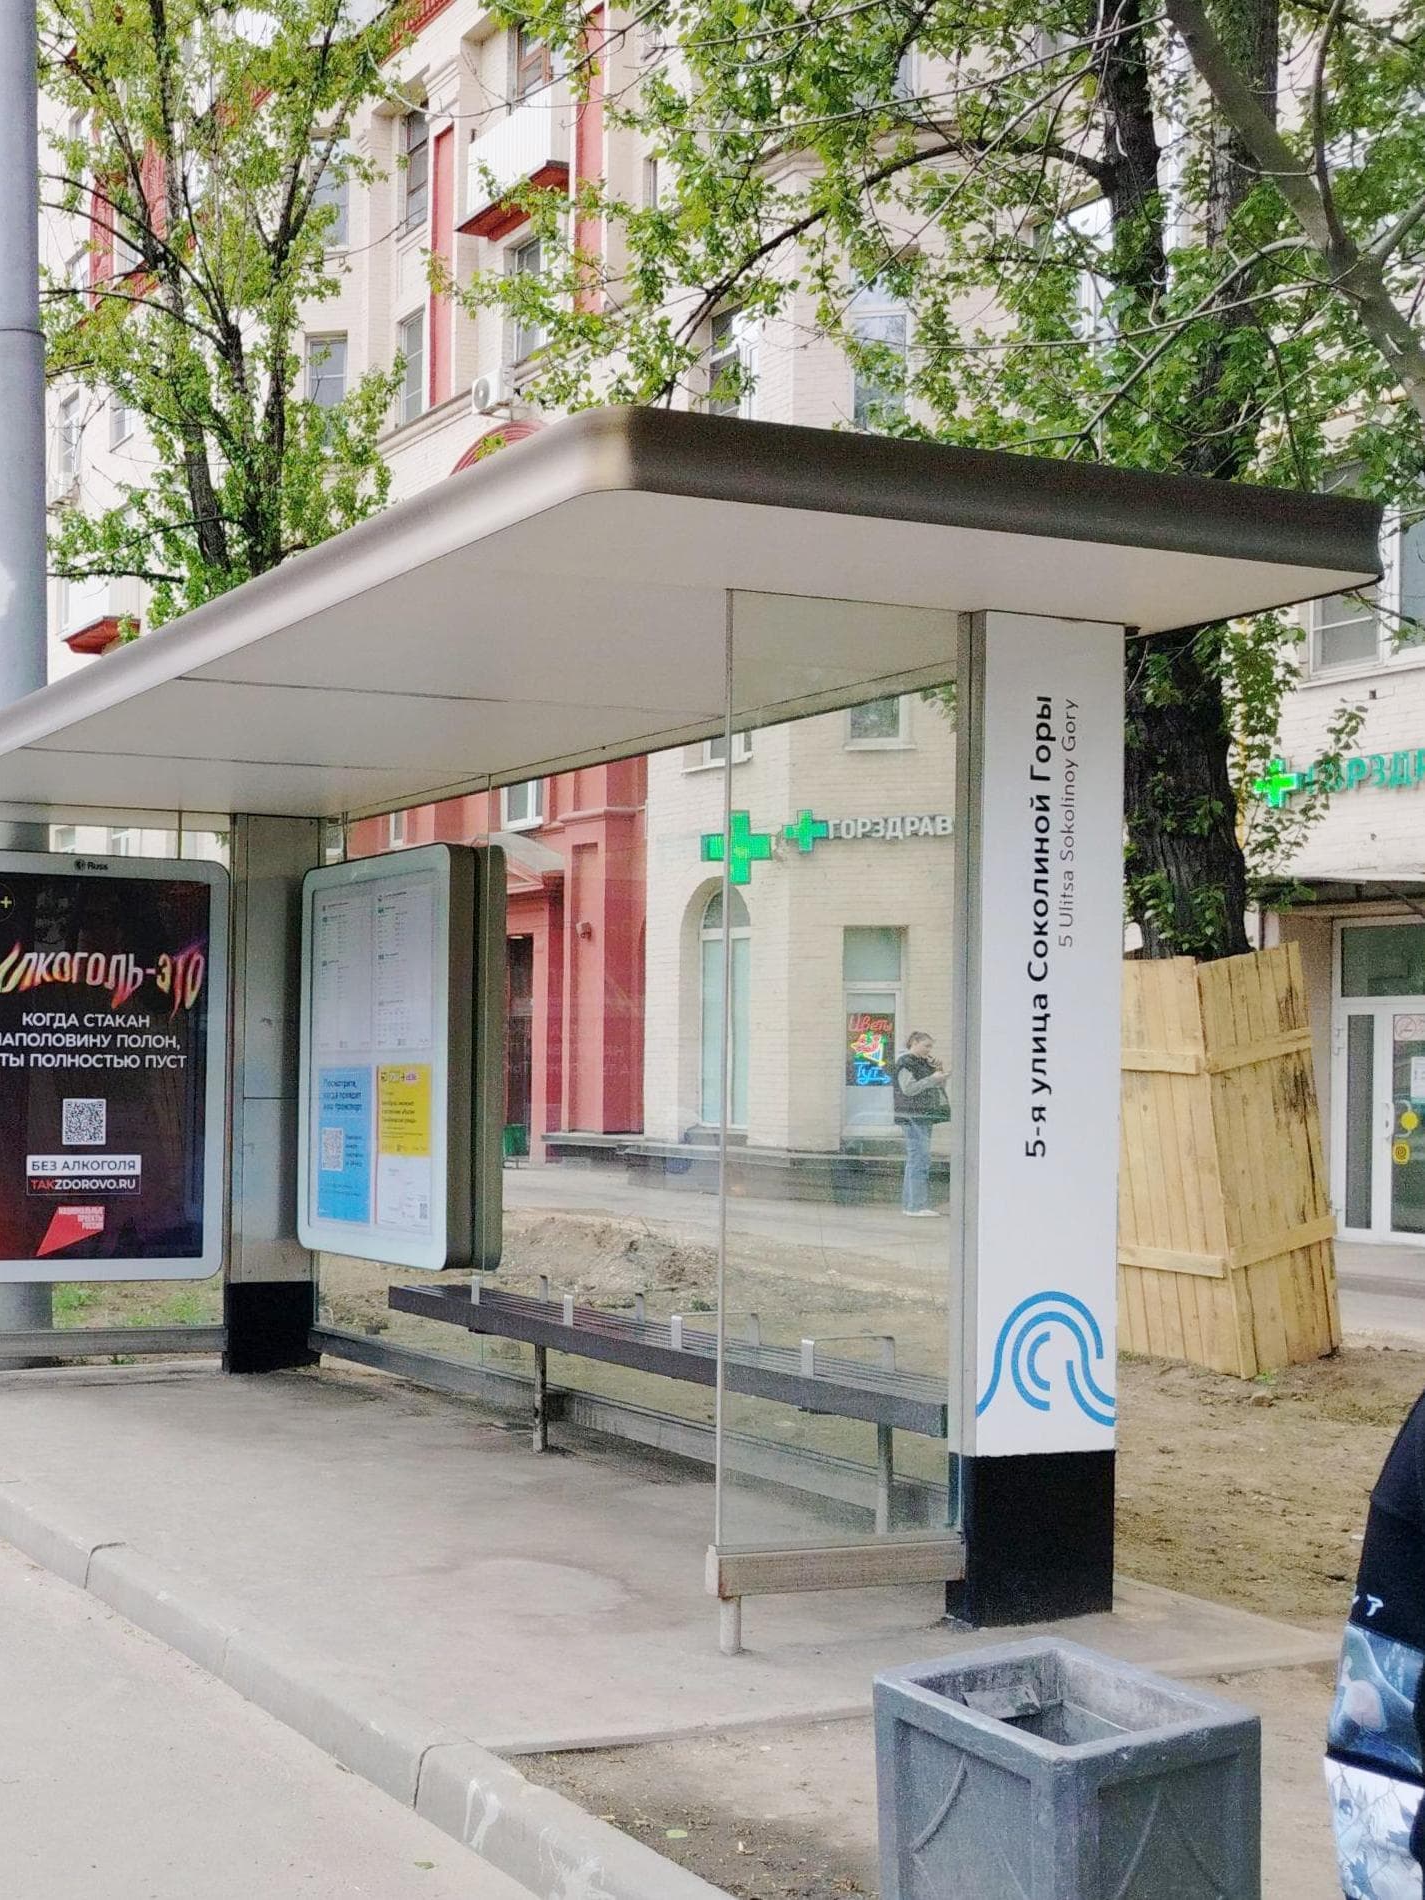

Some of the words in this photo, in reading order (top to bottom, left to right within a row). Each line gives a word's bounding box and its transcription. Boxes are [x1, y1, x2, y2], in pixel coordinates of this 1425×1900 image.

[1030, 696, 1056, 781] Горы
[1061, 698, 1079, 752] Gory
[828, 815, 953, 840] ГОРЗДРАВ
[1060, 758, 1079, 862] Sokolinoy
[1028, 794, 1051, 982] Соколиной
[1058, 870, 1074, 928] Ulitsa
[1059, 935, 1073, 948] 5
[22, 1012, 79, 1029] КОГДА
[83, 1013, 150, 1028] СТАКАН
[0, 1053, 24, 1067] ТЫ
[29, 1053, 140, 1068] ПОЛНОСТЬЮ
[145, 1055, 187, 1069] ПУСТ
[116, 1034, 181, 1050] ПОЛОН,
[1031, 993, 1052, 1095] улица
[1025, 1106, 1046, 1158] 5-я
[31, 1160, 57, 1171] БЕЗ
[61, 1160, 136, 1171] АЛКОГОЛЯ
[31, 1179, 136, 1190] TAKZDOROVO.RU
